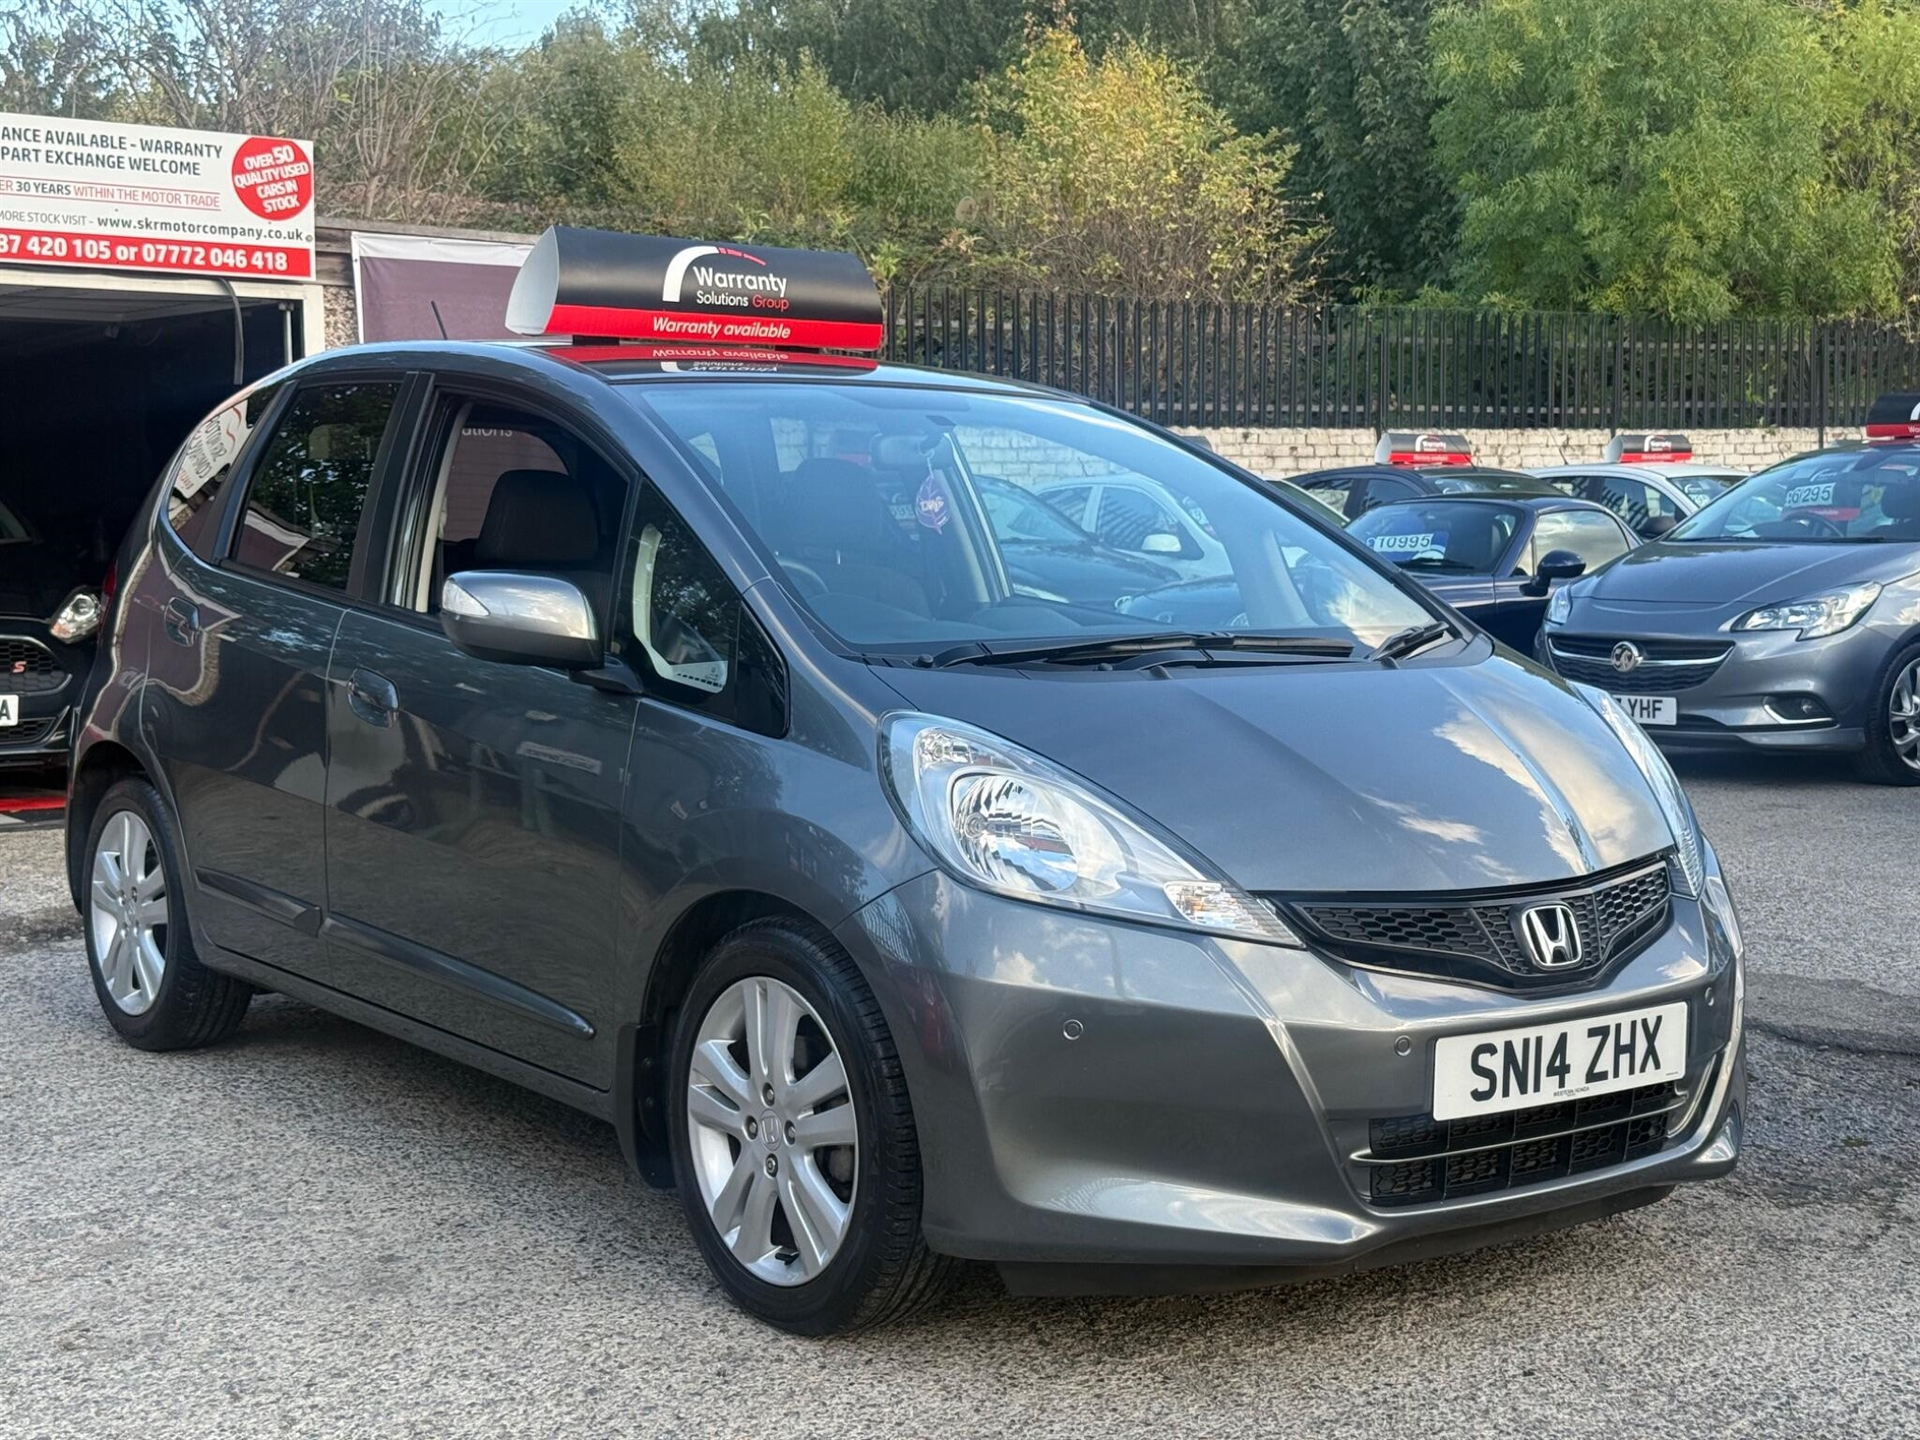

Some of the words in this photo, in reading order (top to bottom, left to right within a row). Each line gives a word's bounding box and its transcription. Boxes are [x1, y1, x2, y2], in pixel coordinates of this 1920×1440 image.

[1, 126, 42, 143] ANCE
[45, 130, 127, 150] AVAILABLE
[140, 138, 222, 158] WARRANTY
[1, 146, 42, 163] PART
[46, 150, 126, 169] EXCHANGE
[129, 156, 201, 176] WELCOME
[243, 153, 276, 170] OVER
[272, 144, 296, 165] 50
[234, 166, 281, 189] QUALITY
[280, 161, 310, 179] USED
[16, 181, 31, 193] 30
[33, 182, 71, 196] YEARS
[73, 185, 114, 199] WITHIN
[117, 188, 139, 201] THE
[141, 191, 182, 204] MOTOR
[184, 194, 220, 208] TRADE
[256, 182, 287, 199] CARS
[284, 179, 299, 194] IN
[262, 194, 301, 213] STOCK
[27, 212, 60, 224] STOCK
[62, 214, 87, 226] VISIT
[97, 216, 303, 241] www.skrmotorcompany.co.uk
[26, 236, 68, 257] 420
[72, 239, 111, 260] 105
[116, 245, 138, 261] or
[142, 243, 206, 266] 07772
[209, 248, 248, 268] 046
[251, 251, 288, 271] 418
[693, 266, 787, 298] Warranty
[696, 290, 749, 307] Solutions
[752, 294, 790, 312] Group
[653, 316, 722, 339] Warranty
[724, 322, 791, 339] available
[1379, 535, 1431, 549] 10995
[1627, 698, 1663, 719] YHF
[1470, 1032, 1571, 1102] SN14
[1585, 1015, 1663, 1084] ZHX
